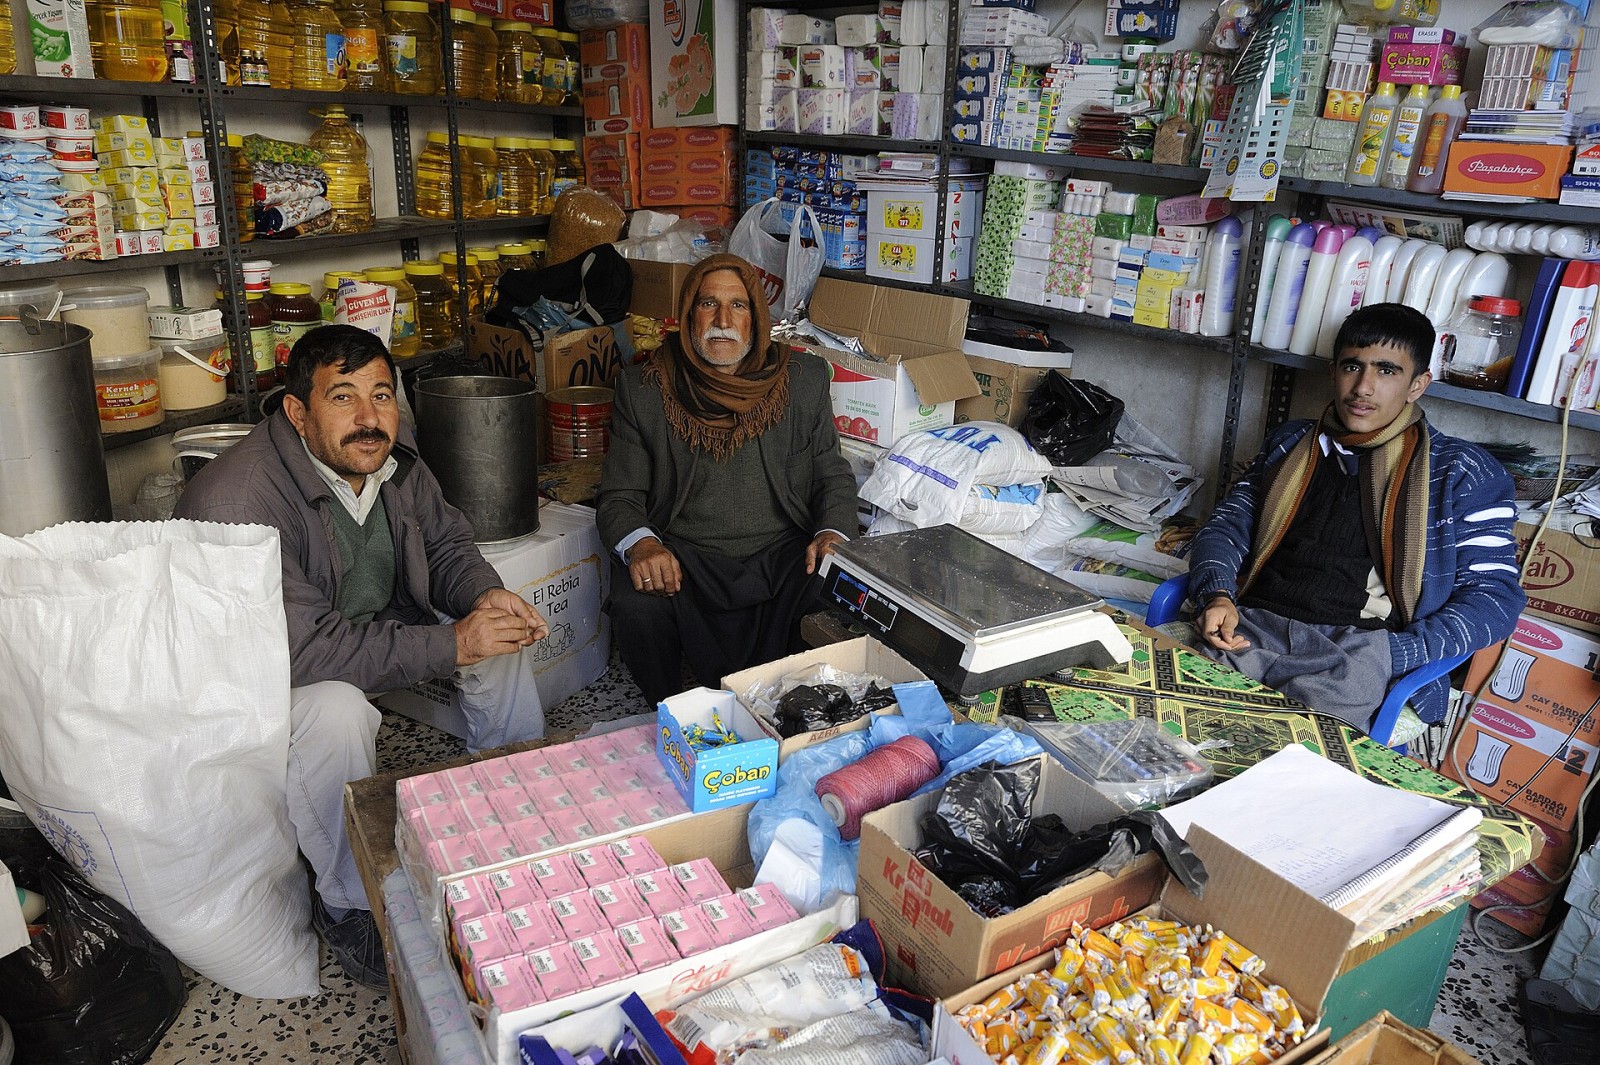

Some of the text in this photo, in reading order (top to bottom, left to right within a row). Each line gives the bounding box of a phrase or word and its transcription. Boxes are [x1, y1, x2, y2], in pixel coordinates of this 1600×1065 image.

[1393, 32, 1409, 40] TRIX
[1386, 52, 1432, 70] Çoban
[1468, 158, 1538, 176] Paşabahçe
[56, 227, 72, 237] vin
[59, 245, 75, 254] vin
[348, 298, 375, 311] GÜVEN
[569, 340, 625, 387] ONA
[106, 383, 140, 393] Kernek
[533, 575, 580, 606] El Rebia
[546, 598, 569, 617] Tea
[1531, 694, 1550, 705] ÇAY
[1474, 702, 1530, 737] Paşabahçe
[808, 727, 841, 743] AZRA
[661, 725, 691, 782] Çoban
[702, 765, 771, 795] Çoban
